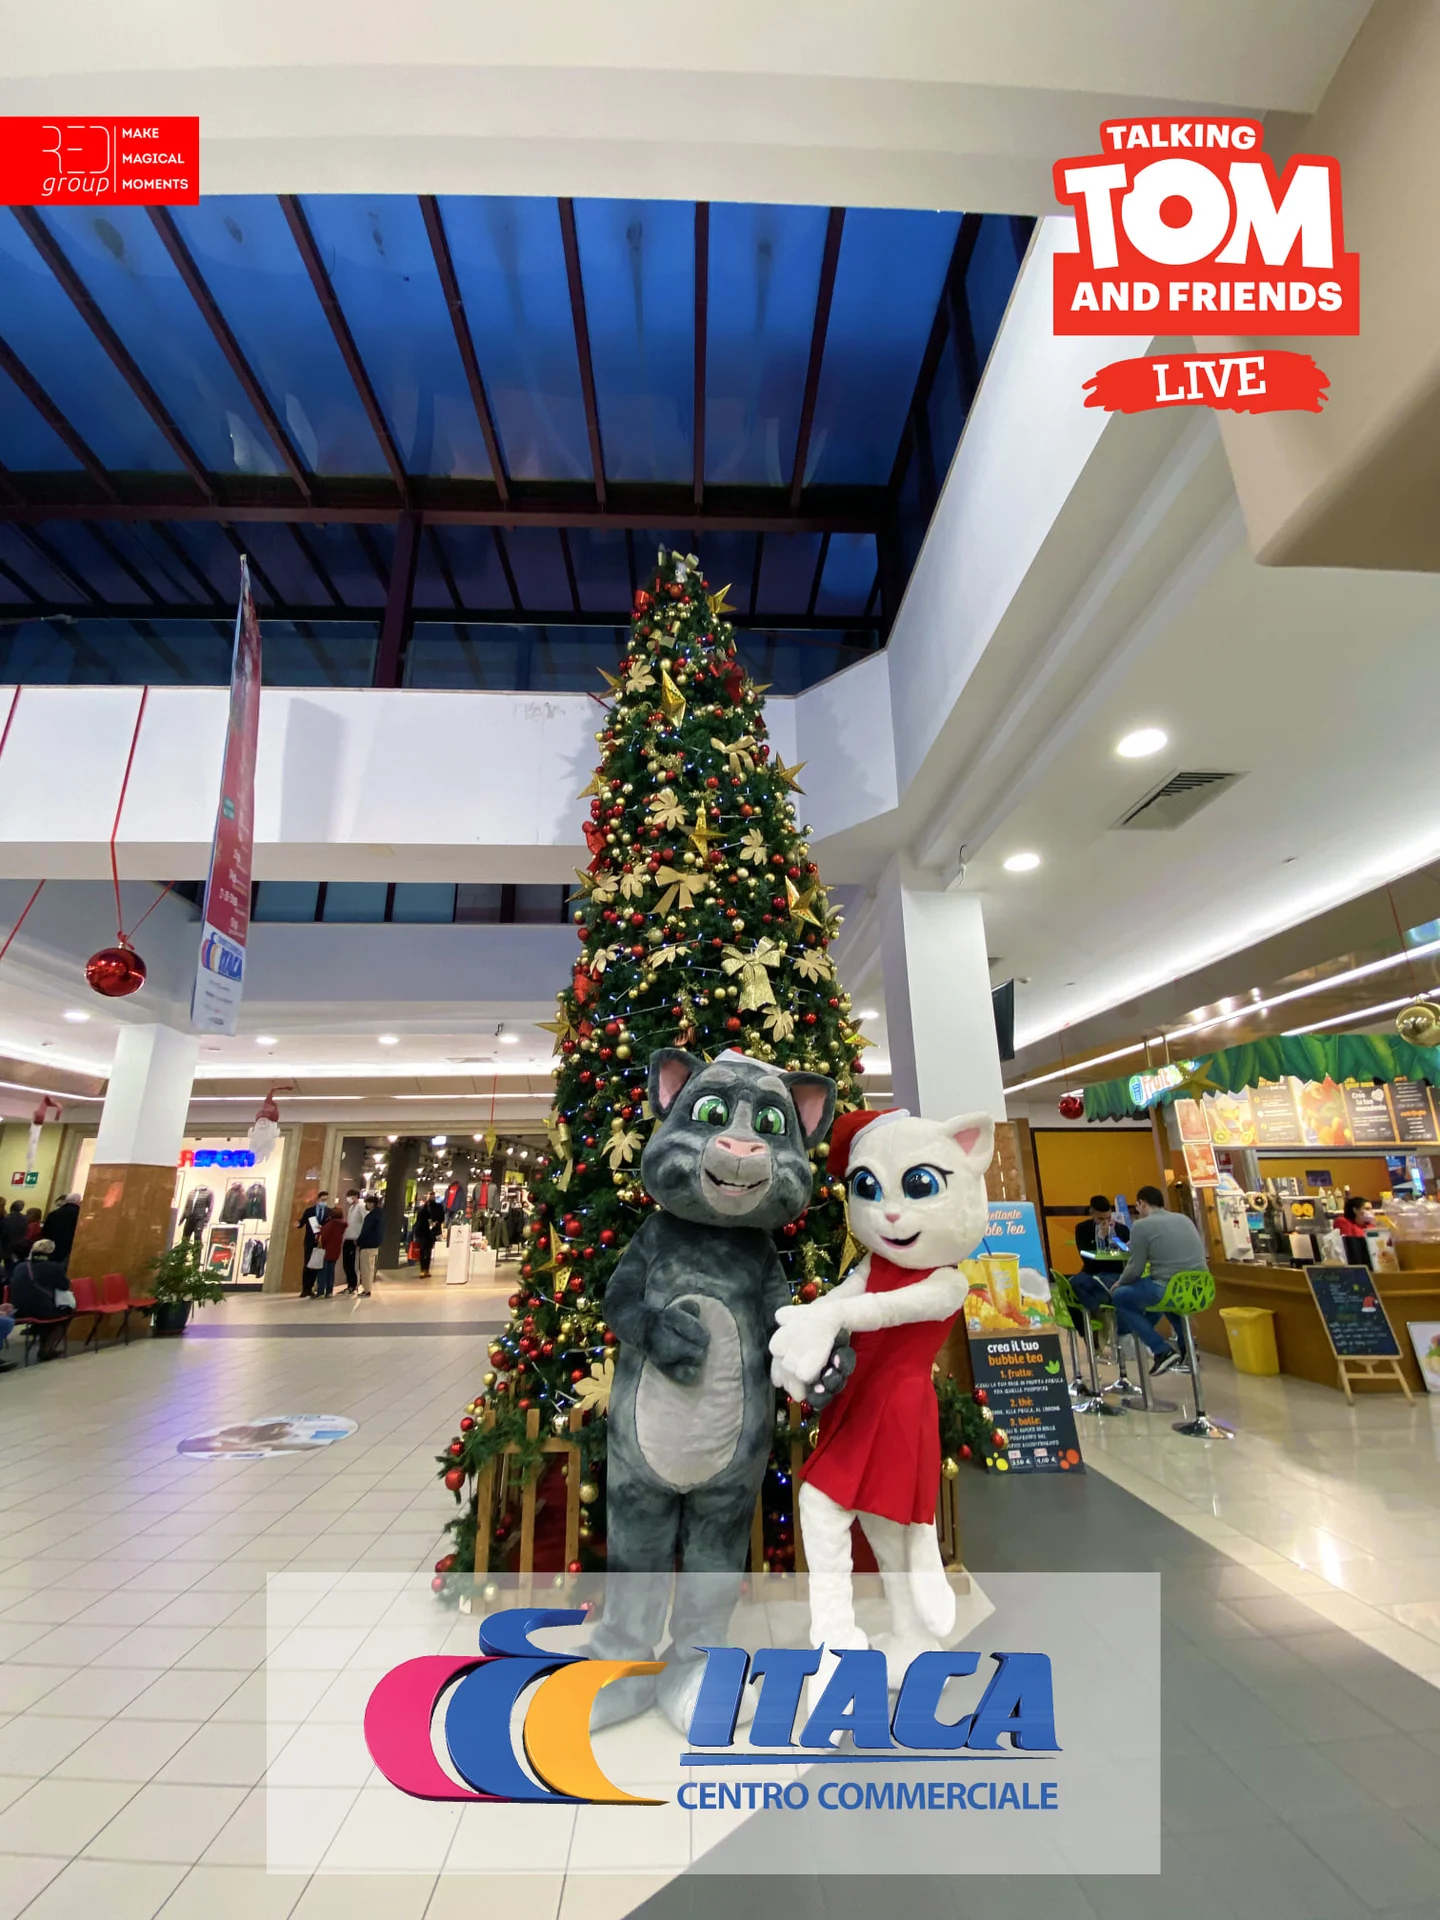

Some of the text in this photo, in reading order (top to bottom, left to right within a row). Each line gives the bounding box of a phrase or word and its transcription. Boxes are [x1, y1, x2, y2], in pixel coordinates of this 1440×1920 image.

[1006, 1221, 1026, 1235] Tea
[987, 1340, 1039, 1353] crea il tuo
[988, 1353, 1043, 1366] bubble tea
